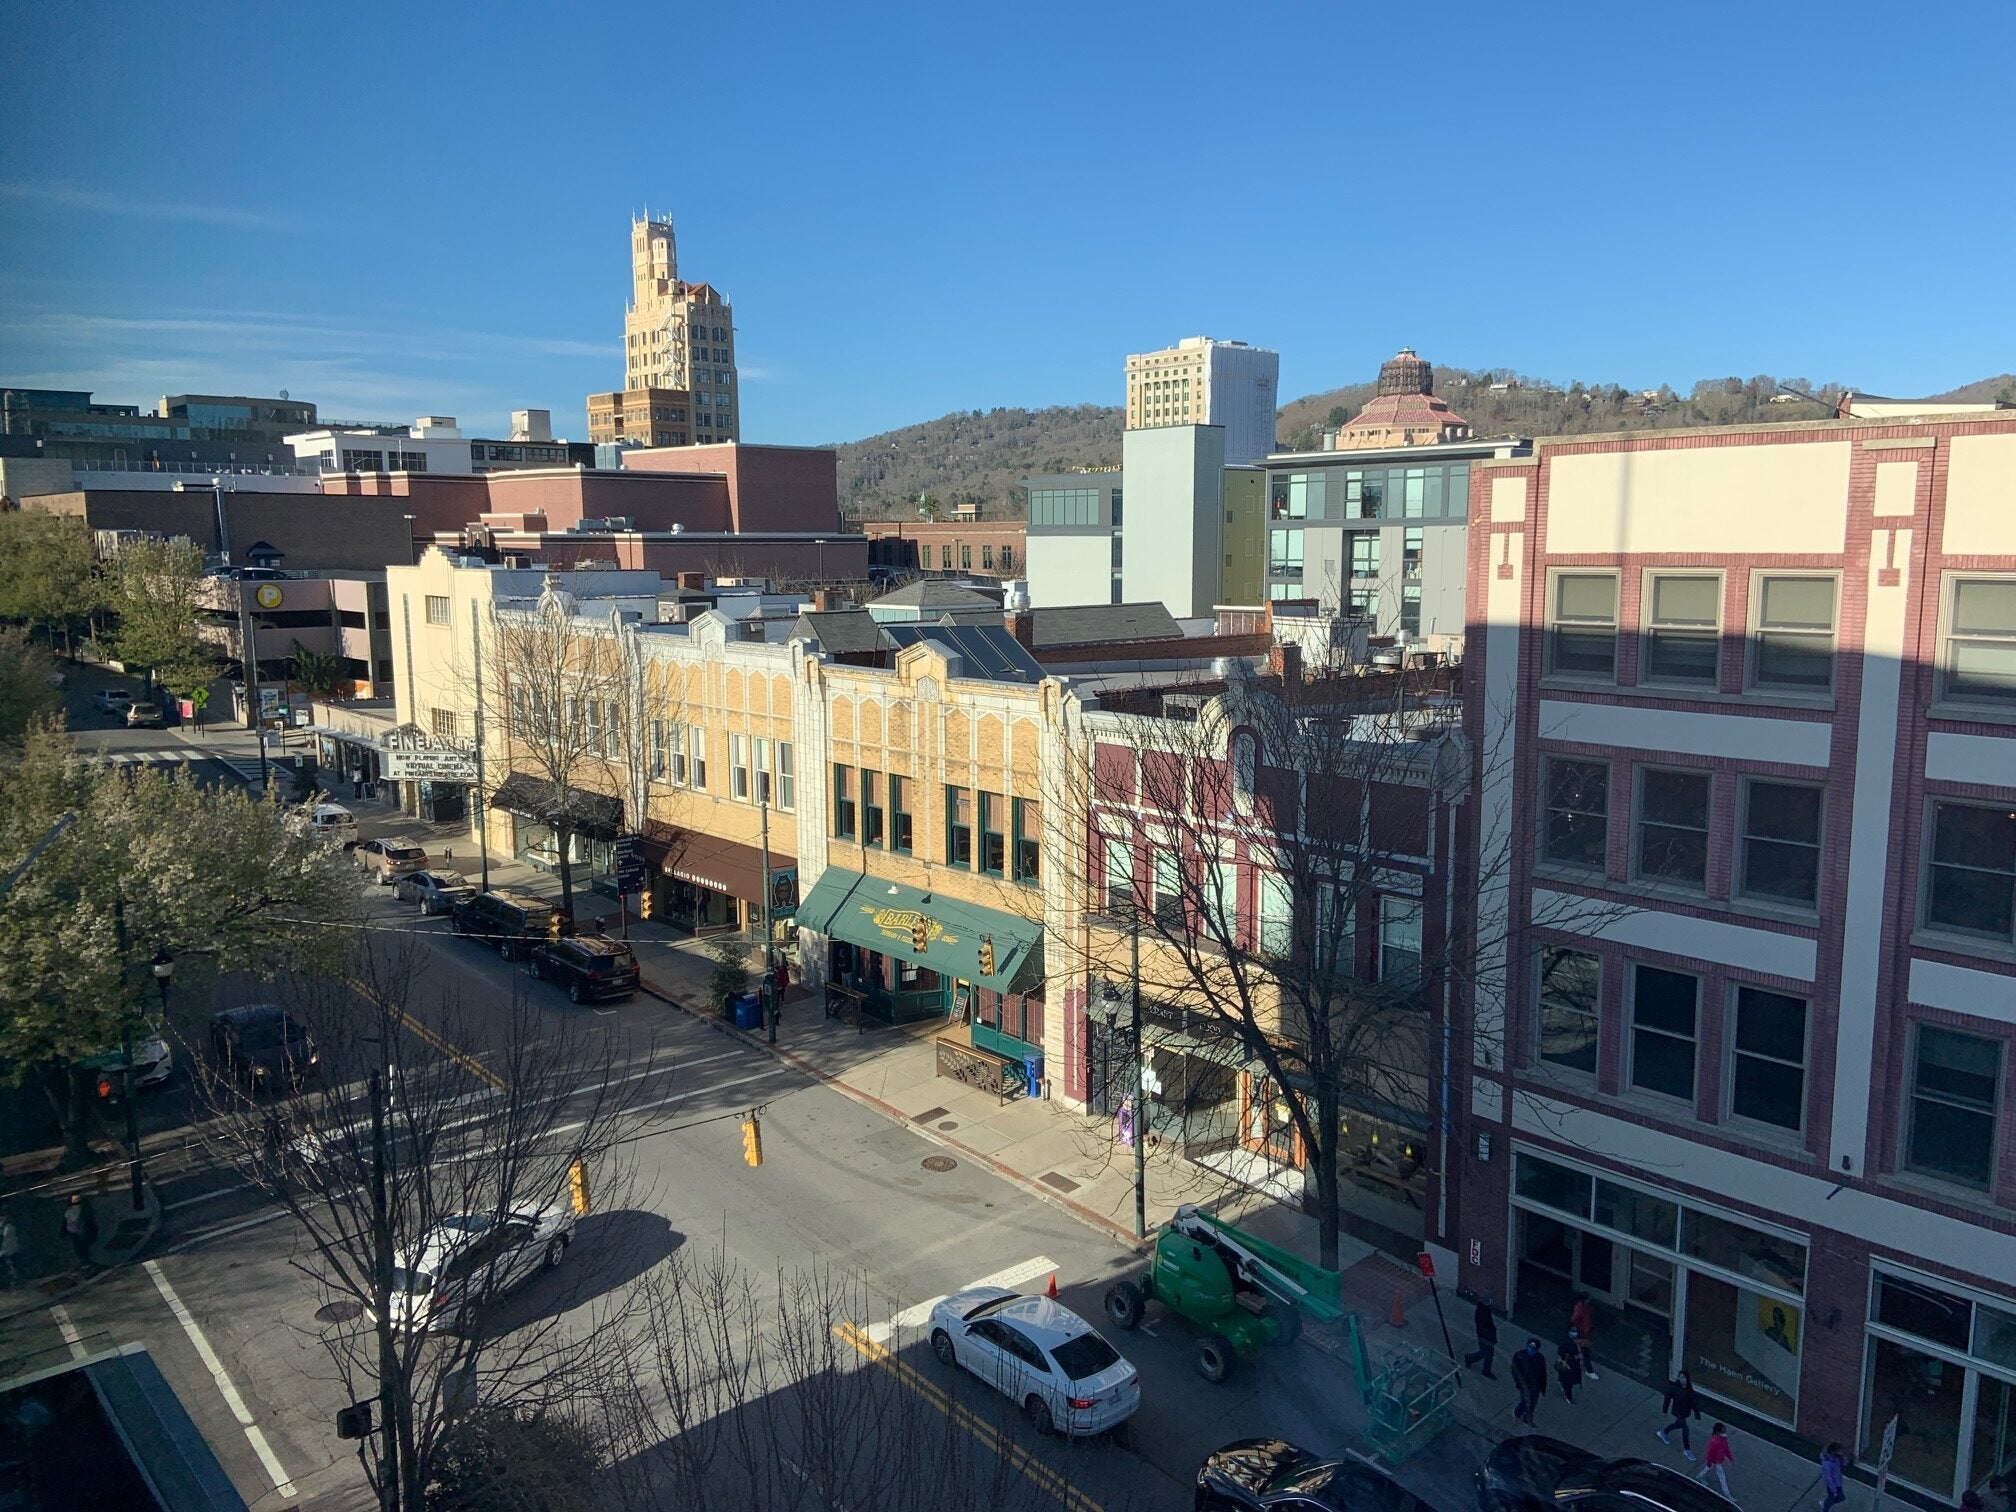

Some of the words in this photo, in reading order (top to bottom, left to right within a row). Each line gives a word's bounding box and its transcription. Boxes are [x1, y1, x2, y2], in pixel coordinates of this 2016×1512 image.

[264, 589, 277, 604] P
[390, 736, 425, 751] FINE
[1699, 1356, 1717, 1370] The
[1719, 1364, 1743, 1379] Haen
[1745, 1375, 1781, 1396] Gallery
